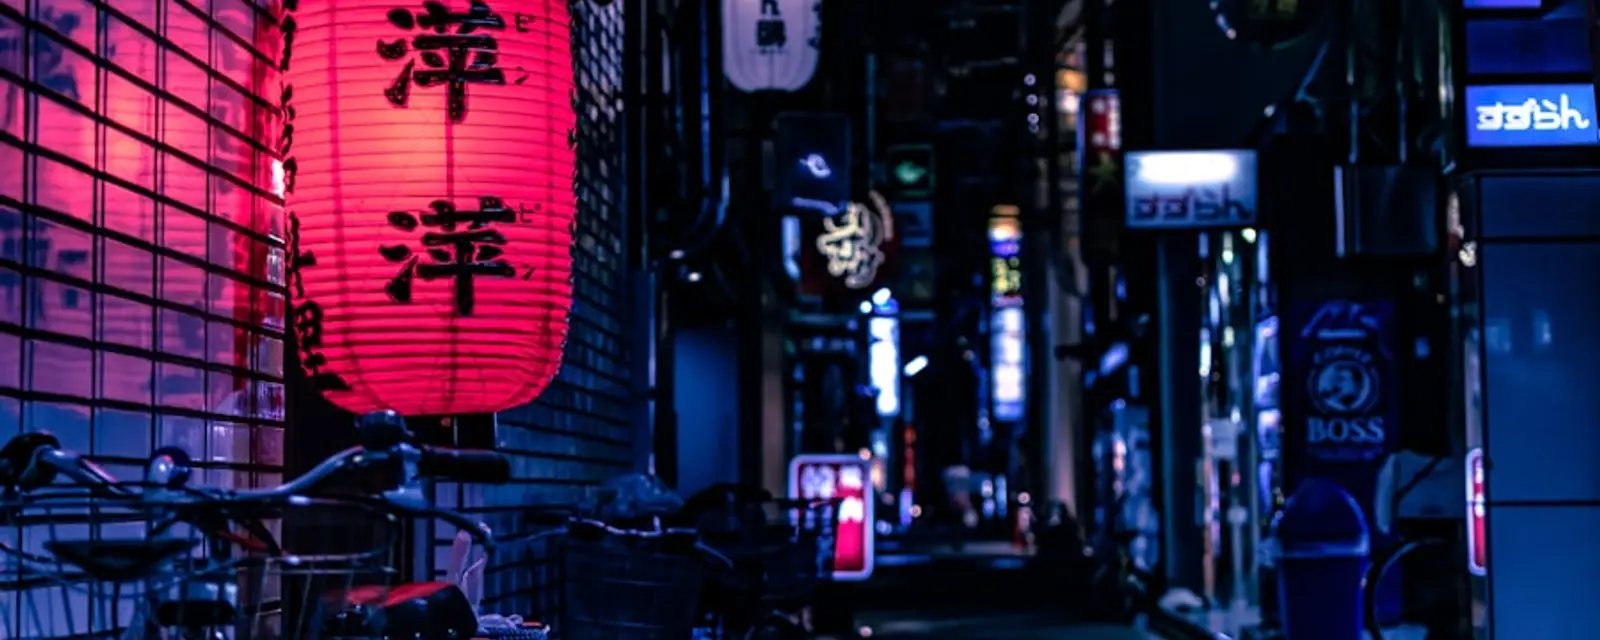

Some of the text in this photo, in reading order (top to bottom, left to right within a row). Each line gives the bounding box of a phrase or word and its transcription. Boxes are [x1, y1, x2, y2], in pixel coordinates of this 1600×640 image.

[1475, 92, 1591, 131] すずらん
[1134, 183, 1253, 221] すずらん
[1306, 415, 1386, 444] BOSS
